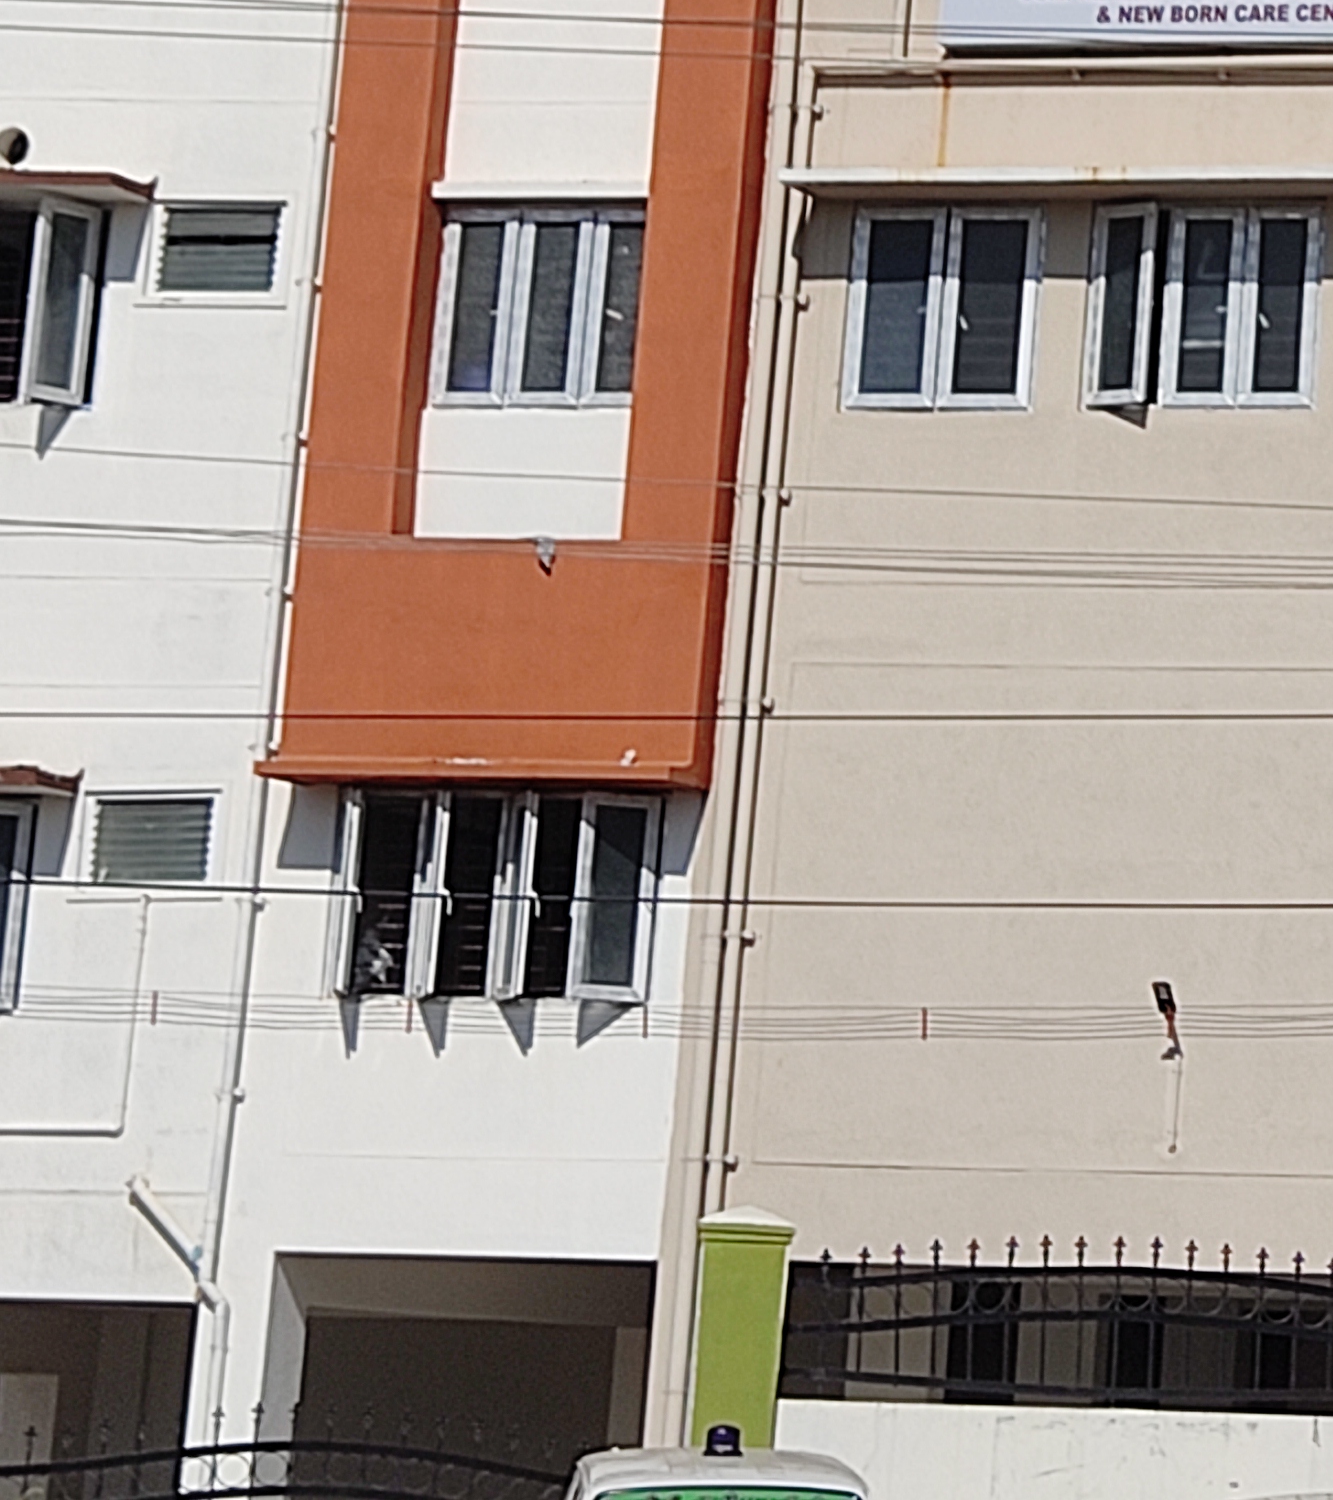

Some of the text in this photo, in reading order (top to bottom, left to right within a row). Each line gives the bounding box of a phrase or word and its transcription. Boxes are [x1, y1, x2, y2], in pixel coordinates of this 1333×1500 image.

[1097, 5, 1111, 24] &
[1118, 5, 1164, 24] NEW
[1170, 4, 1228, 23] BORN
[1234, 3, 1289, 23] CARE
